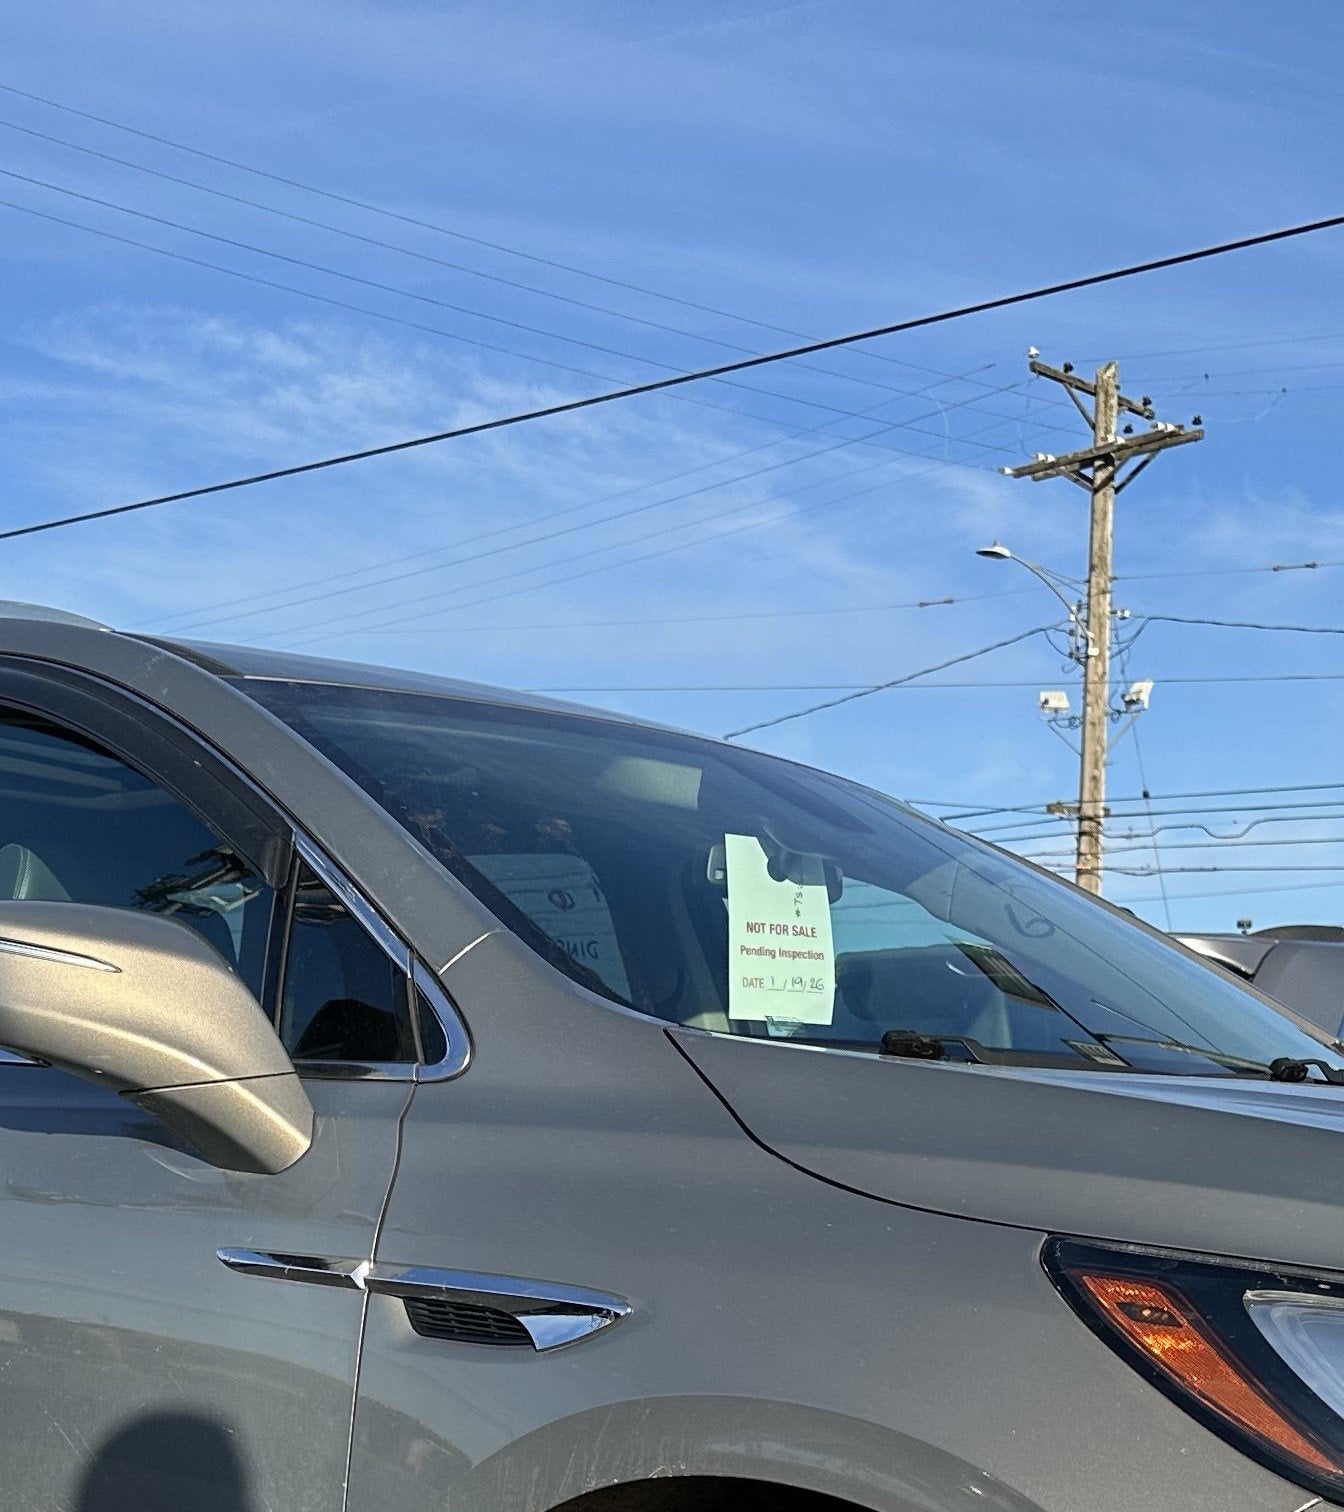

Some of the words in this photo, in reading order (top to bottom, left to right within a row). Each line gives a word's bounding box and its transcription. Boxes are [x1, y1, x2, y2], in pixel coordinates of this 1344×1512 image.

[746, 921, 767, 934] NOT
[769, 923, 789, 936] FOR
[792, 925, 818, 938] SALE
[740, 945, 776, 960] Pending
[778, 948, 825, 960] Inspection
[742, 977, 765, 988] DATE
